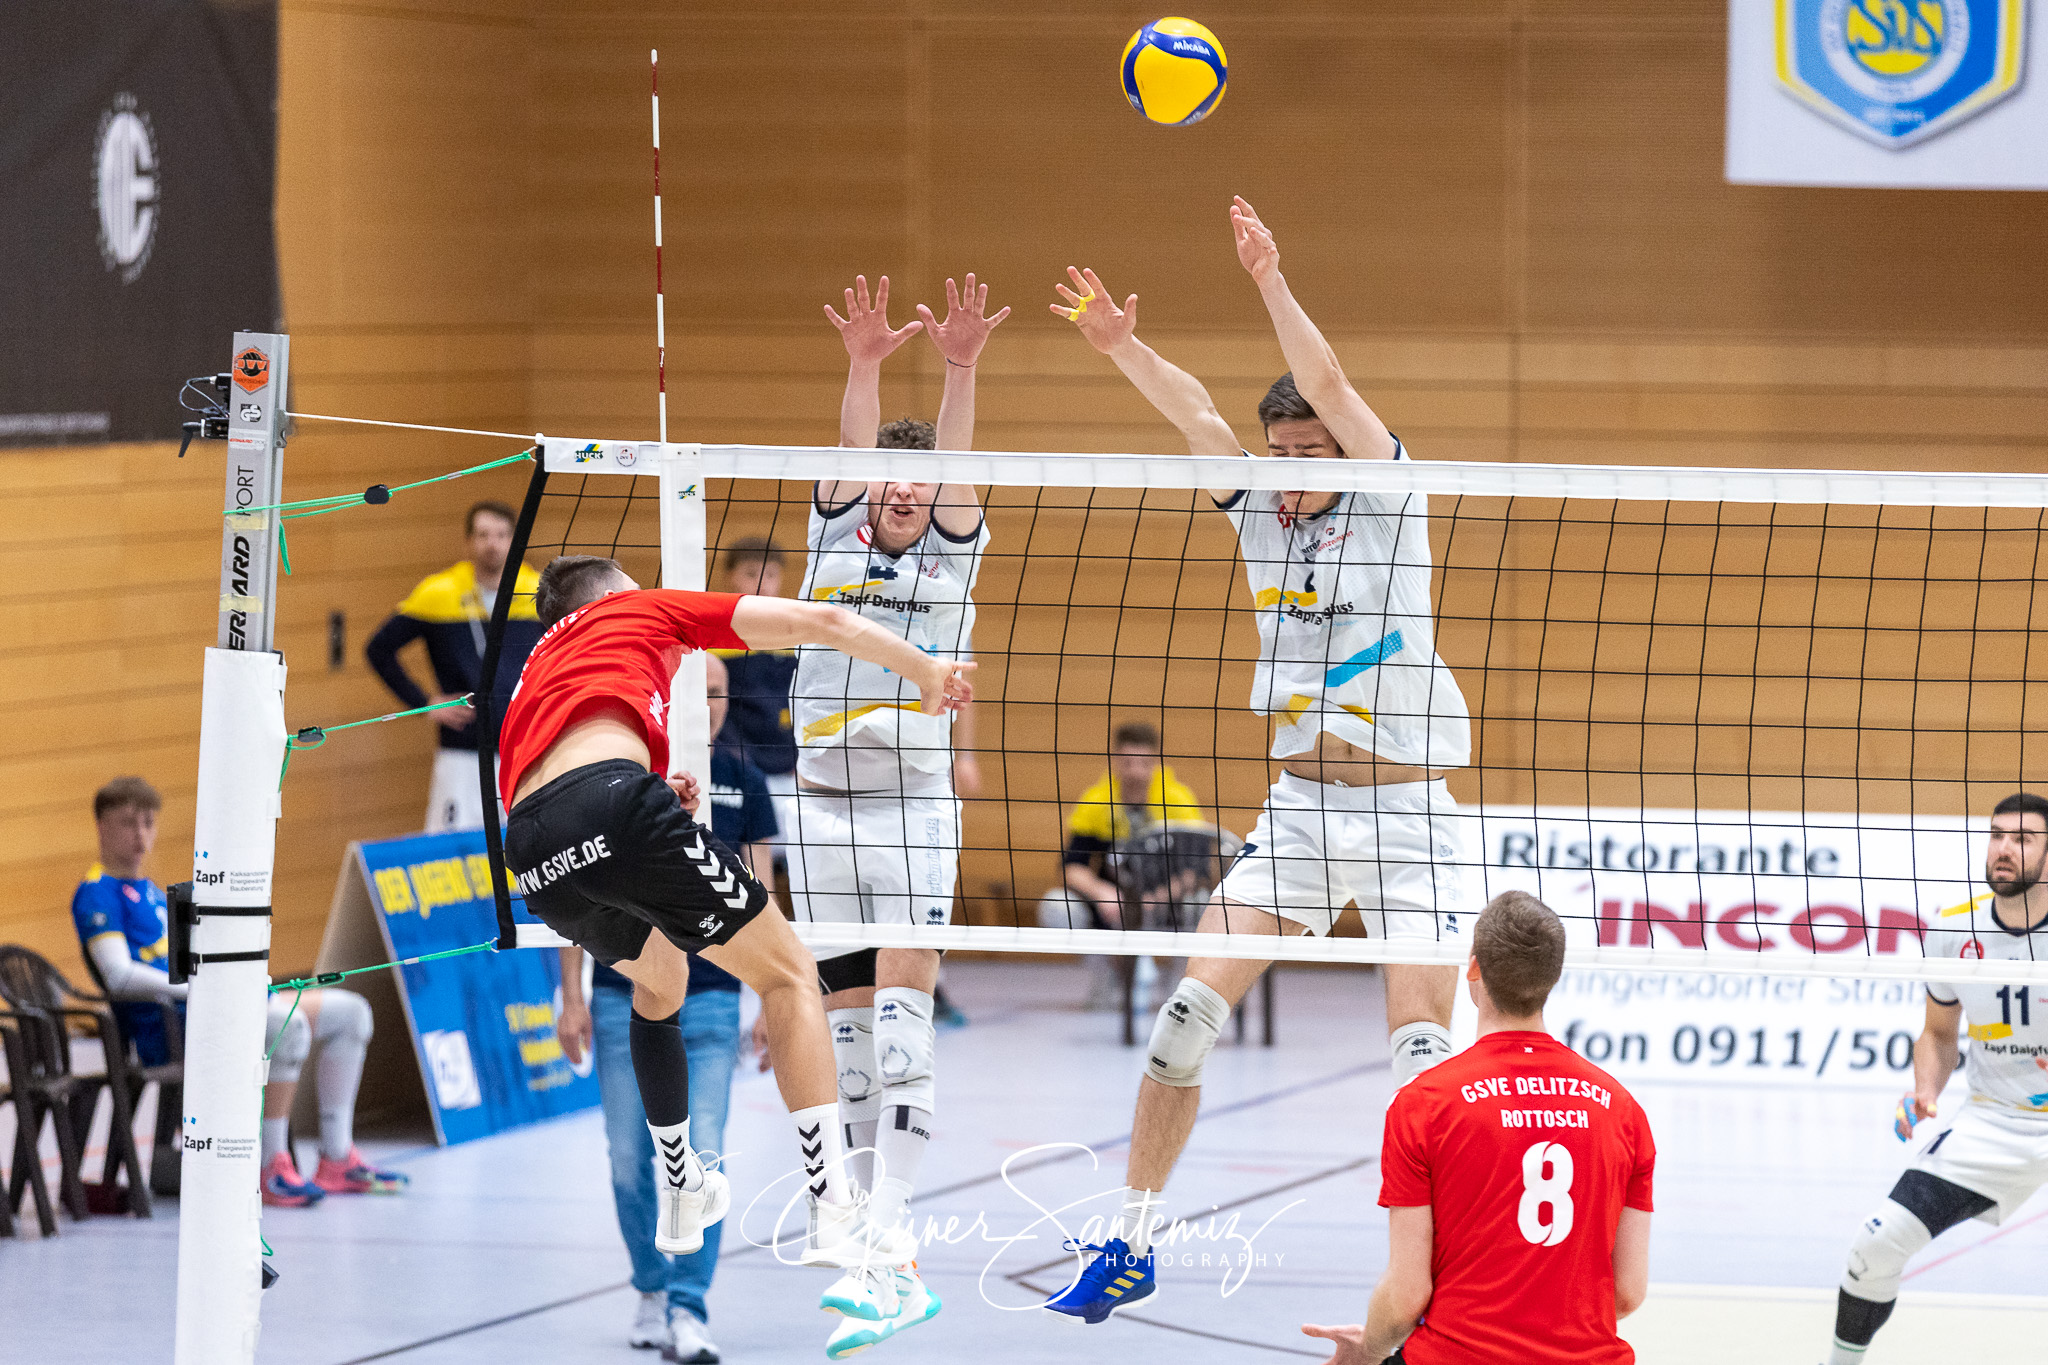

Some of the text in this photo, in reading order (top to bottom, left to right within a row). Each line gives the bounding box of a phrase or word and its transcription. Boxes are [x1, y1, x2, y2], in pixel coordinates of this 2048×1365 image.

[229, 464, 254, 650] ERARD PORT
[1501, 830, 1841, 876] Ristorante
[195, 869, 225, 886] Zapf
[703, 919, 724, 938] hummel
[1996, 984, 2030, 1027] 11
[1672, 1023, 1912, 1076] 0911/50
[1460, 1076, 1612, 1110] GSVE DELITZSCH
[1500, 1109, 1589, 1129] ROTTOSCH
[184, 1135, 212, 1152] Zapf
[1517, 1140, 1575, 1247] 8
